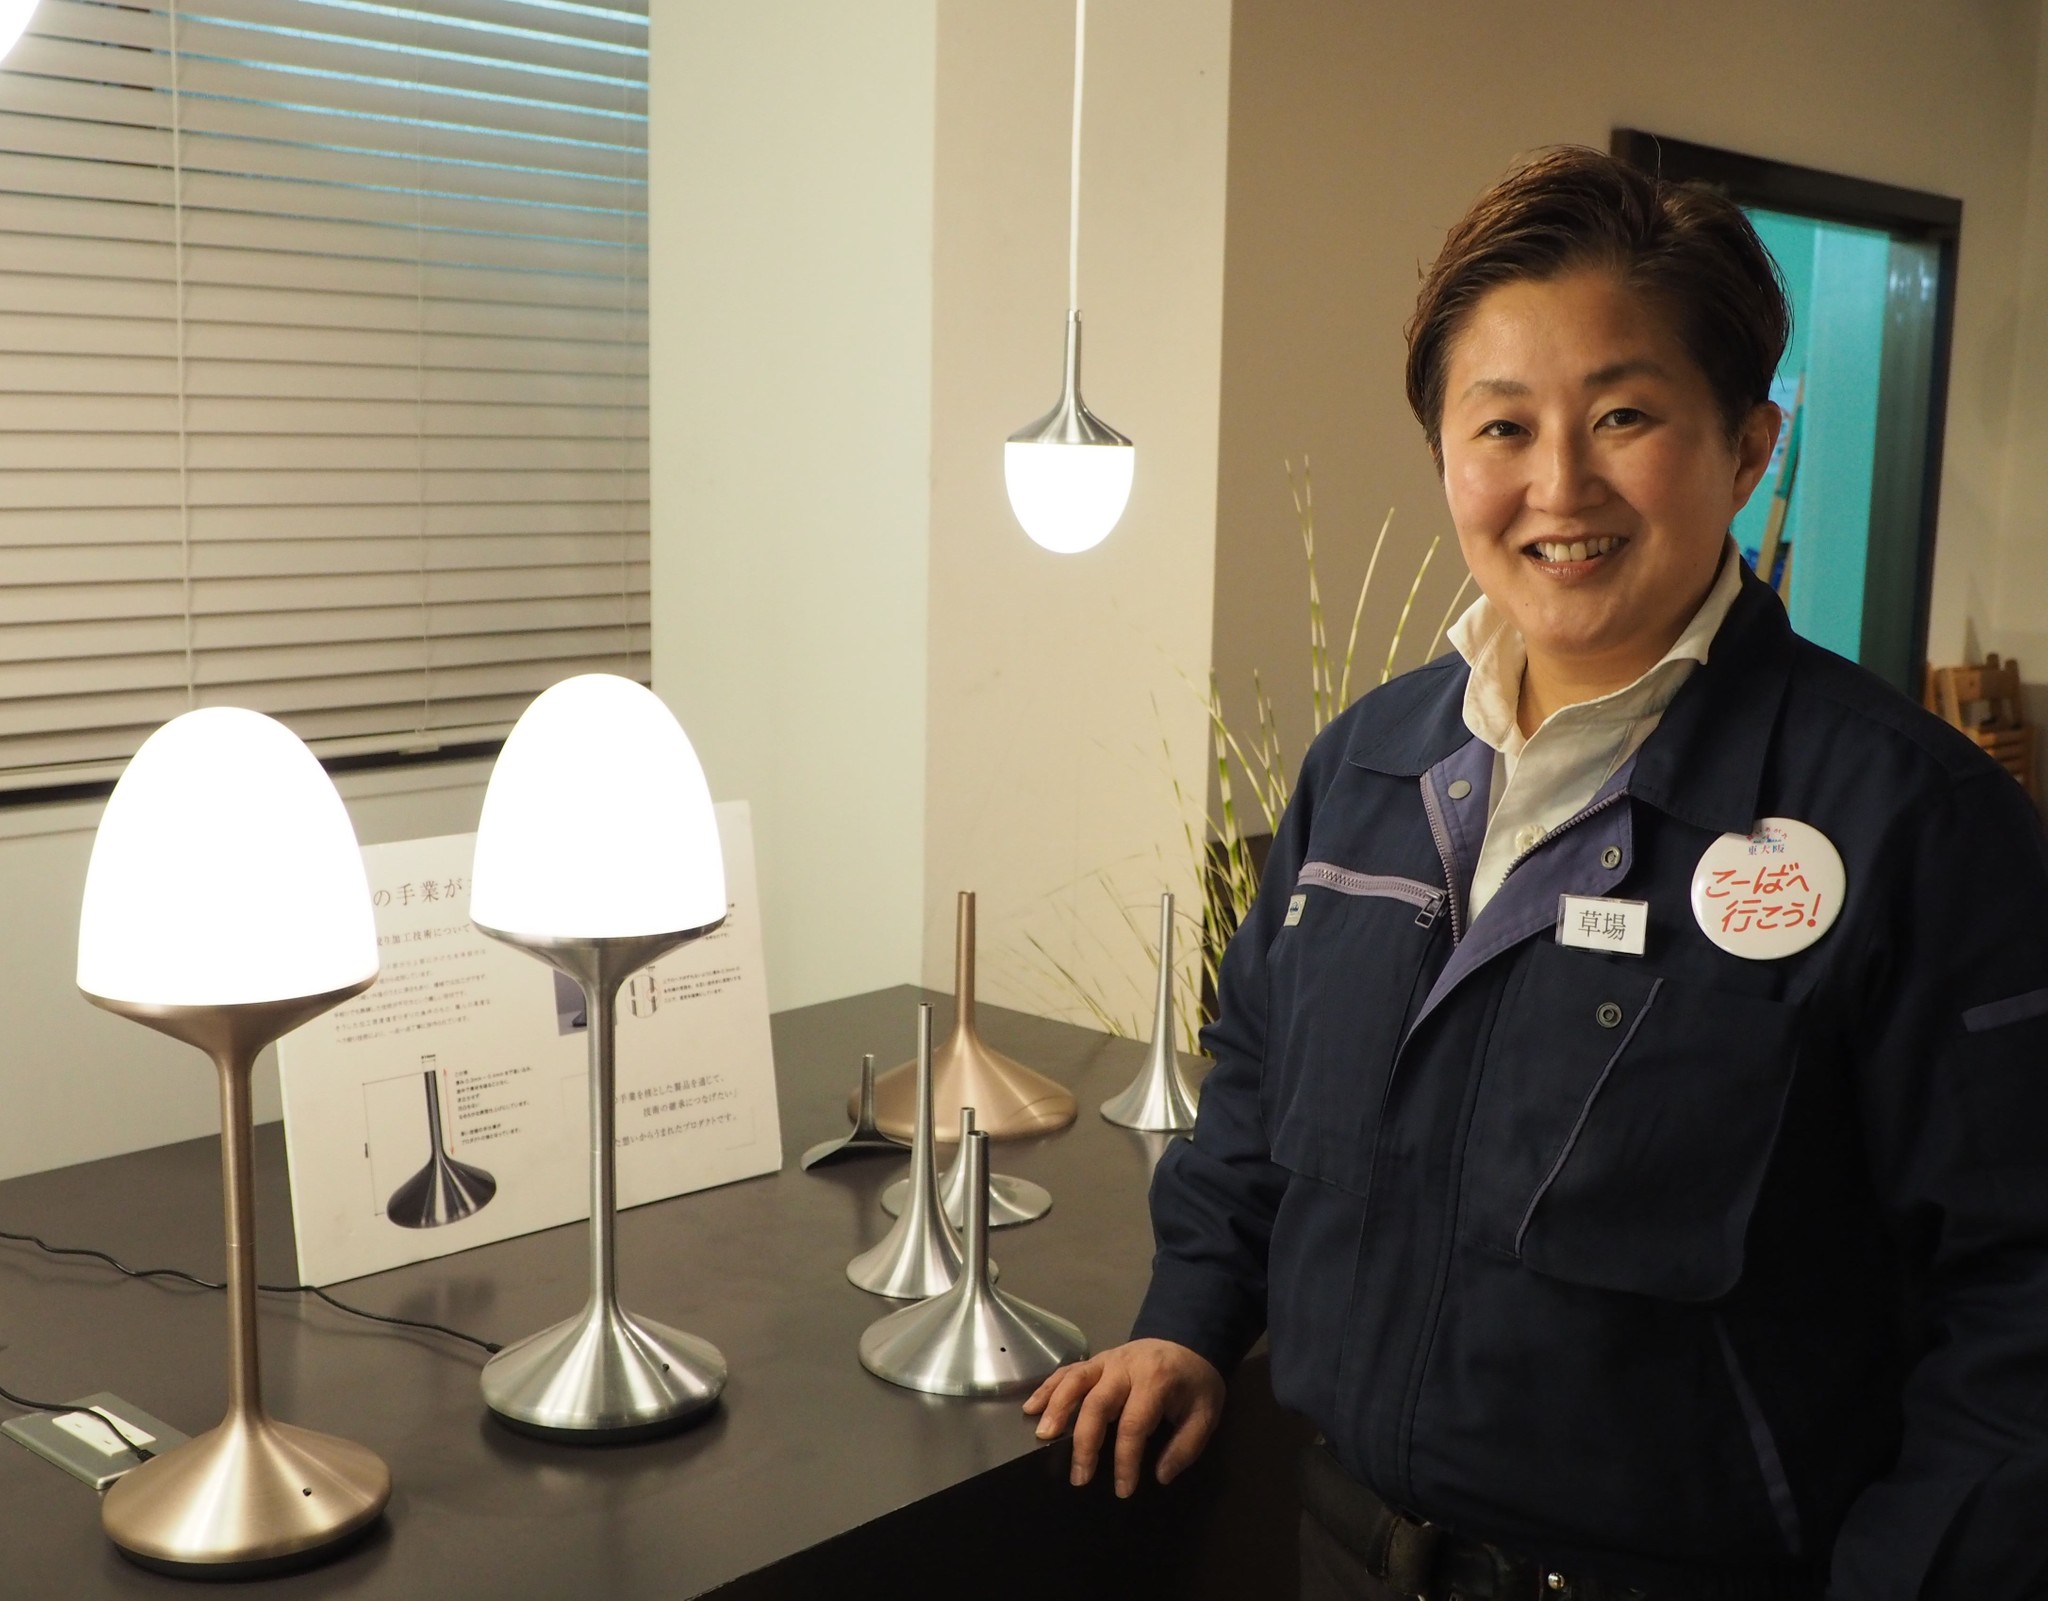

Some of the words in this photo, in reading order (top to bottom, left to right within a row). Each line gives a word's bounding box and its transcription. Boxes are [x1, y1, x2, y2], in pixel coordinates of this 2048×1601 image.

[1748, 843, 1785, 856] 東大阪
[373, 877, 471, 906] の手業が
[1705, 862, 1809, 898] こーばへ
[1577, 909, 1626, 941] 草場
